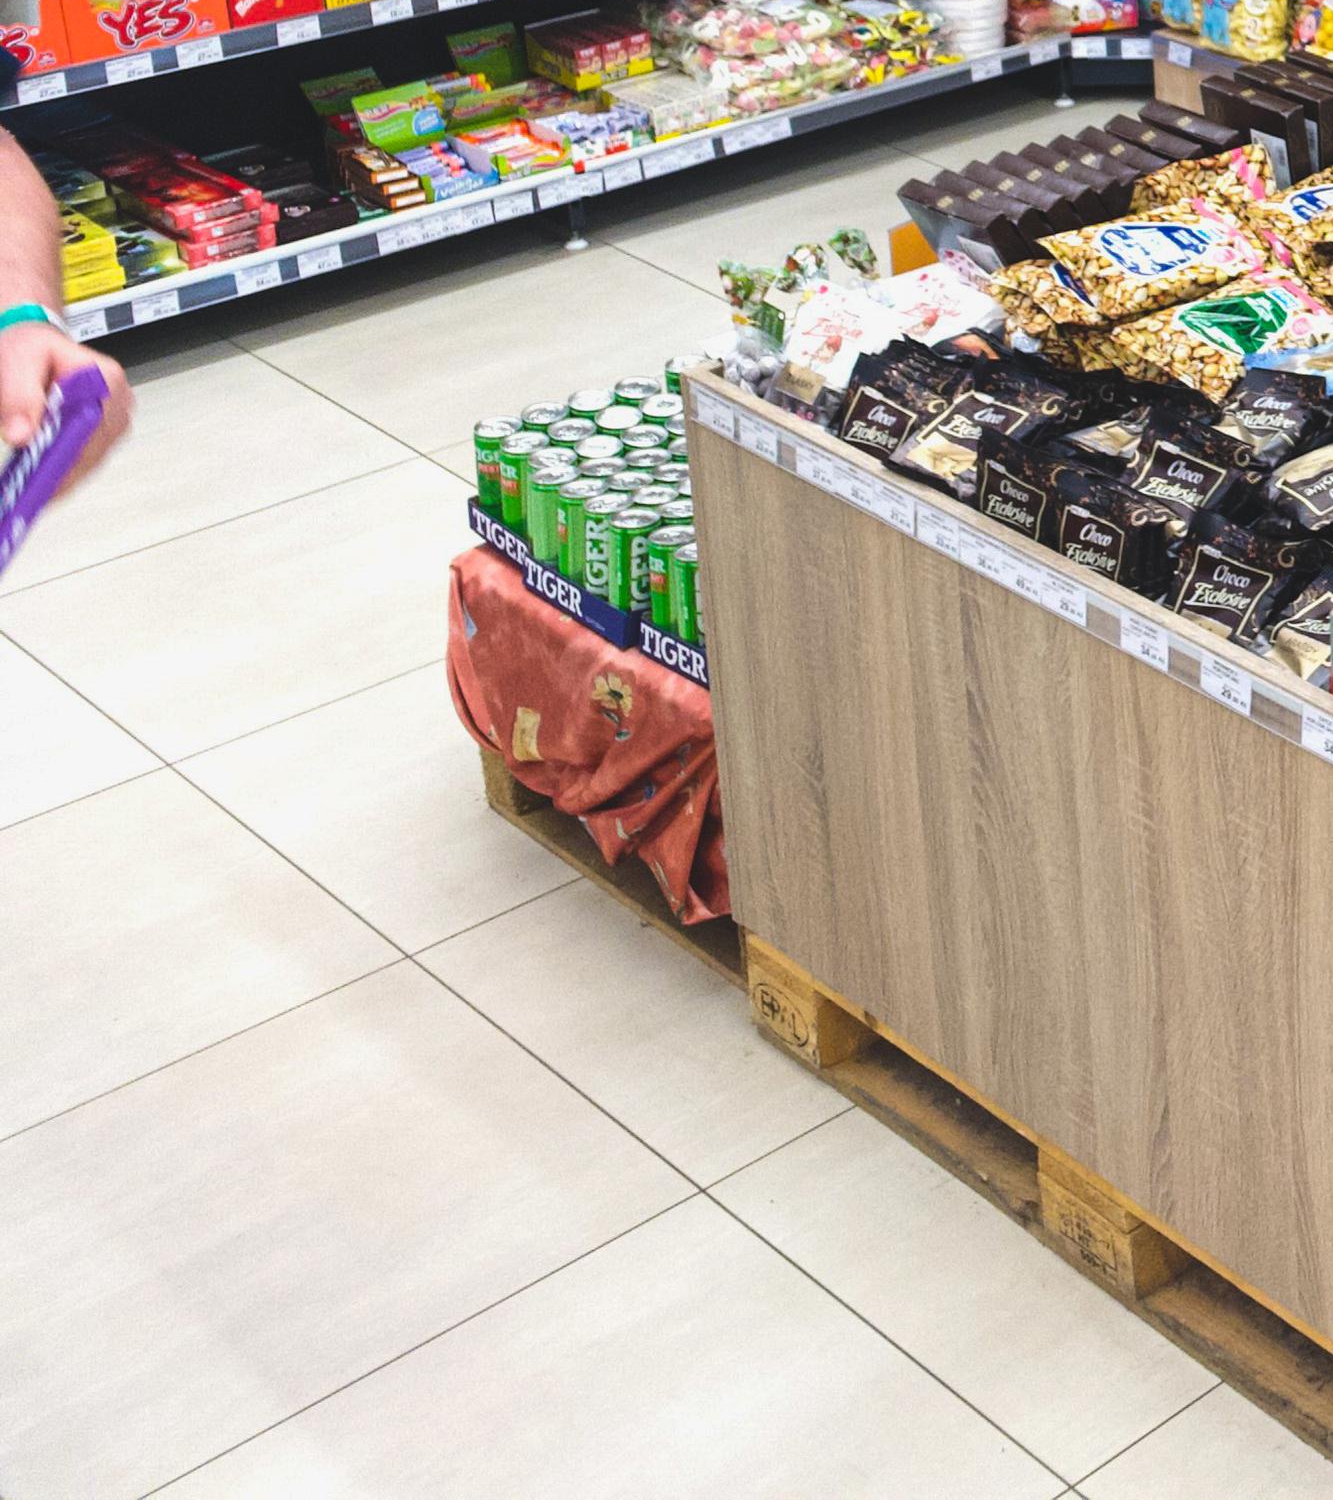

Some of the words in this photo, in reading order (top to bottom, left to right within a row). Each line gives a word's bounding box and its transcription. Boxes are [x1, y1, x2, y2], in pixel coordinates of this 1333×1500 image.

[1167, 460, 1204, 485] Choco
[999, 478, 1030, 503] Choco
[1079, 523, 1113, 546] Choco
[586, 518, 610, 597] IGER
[524, 559, 583, 617] TIGER
[1212, 564, 1251, 588] Choco
[640, 622, 710, 684] TIGER
